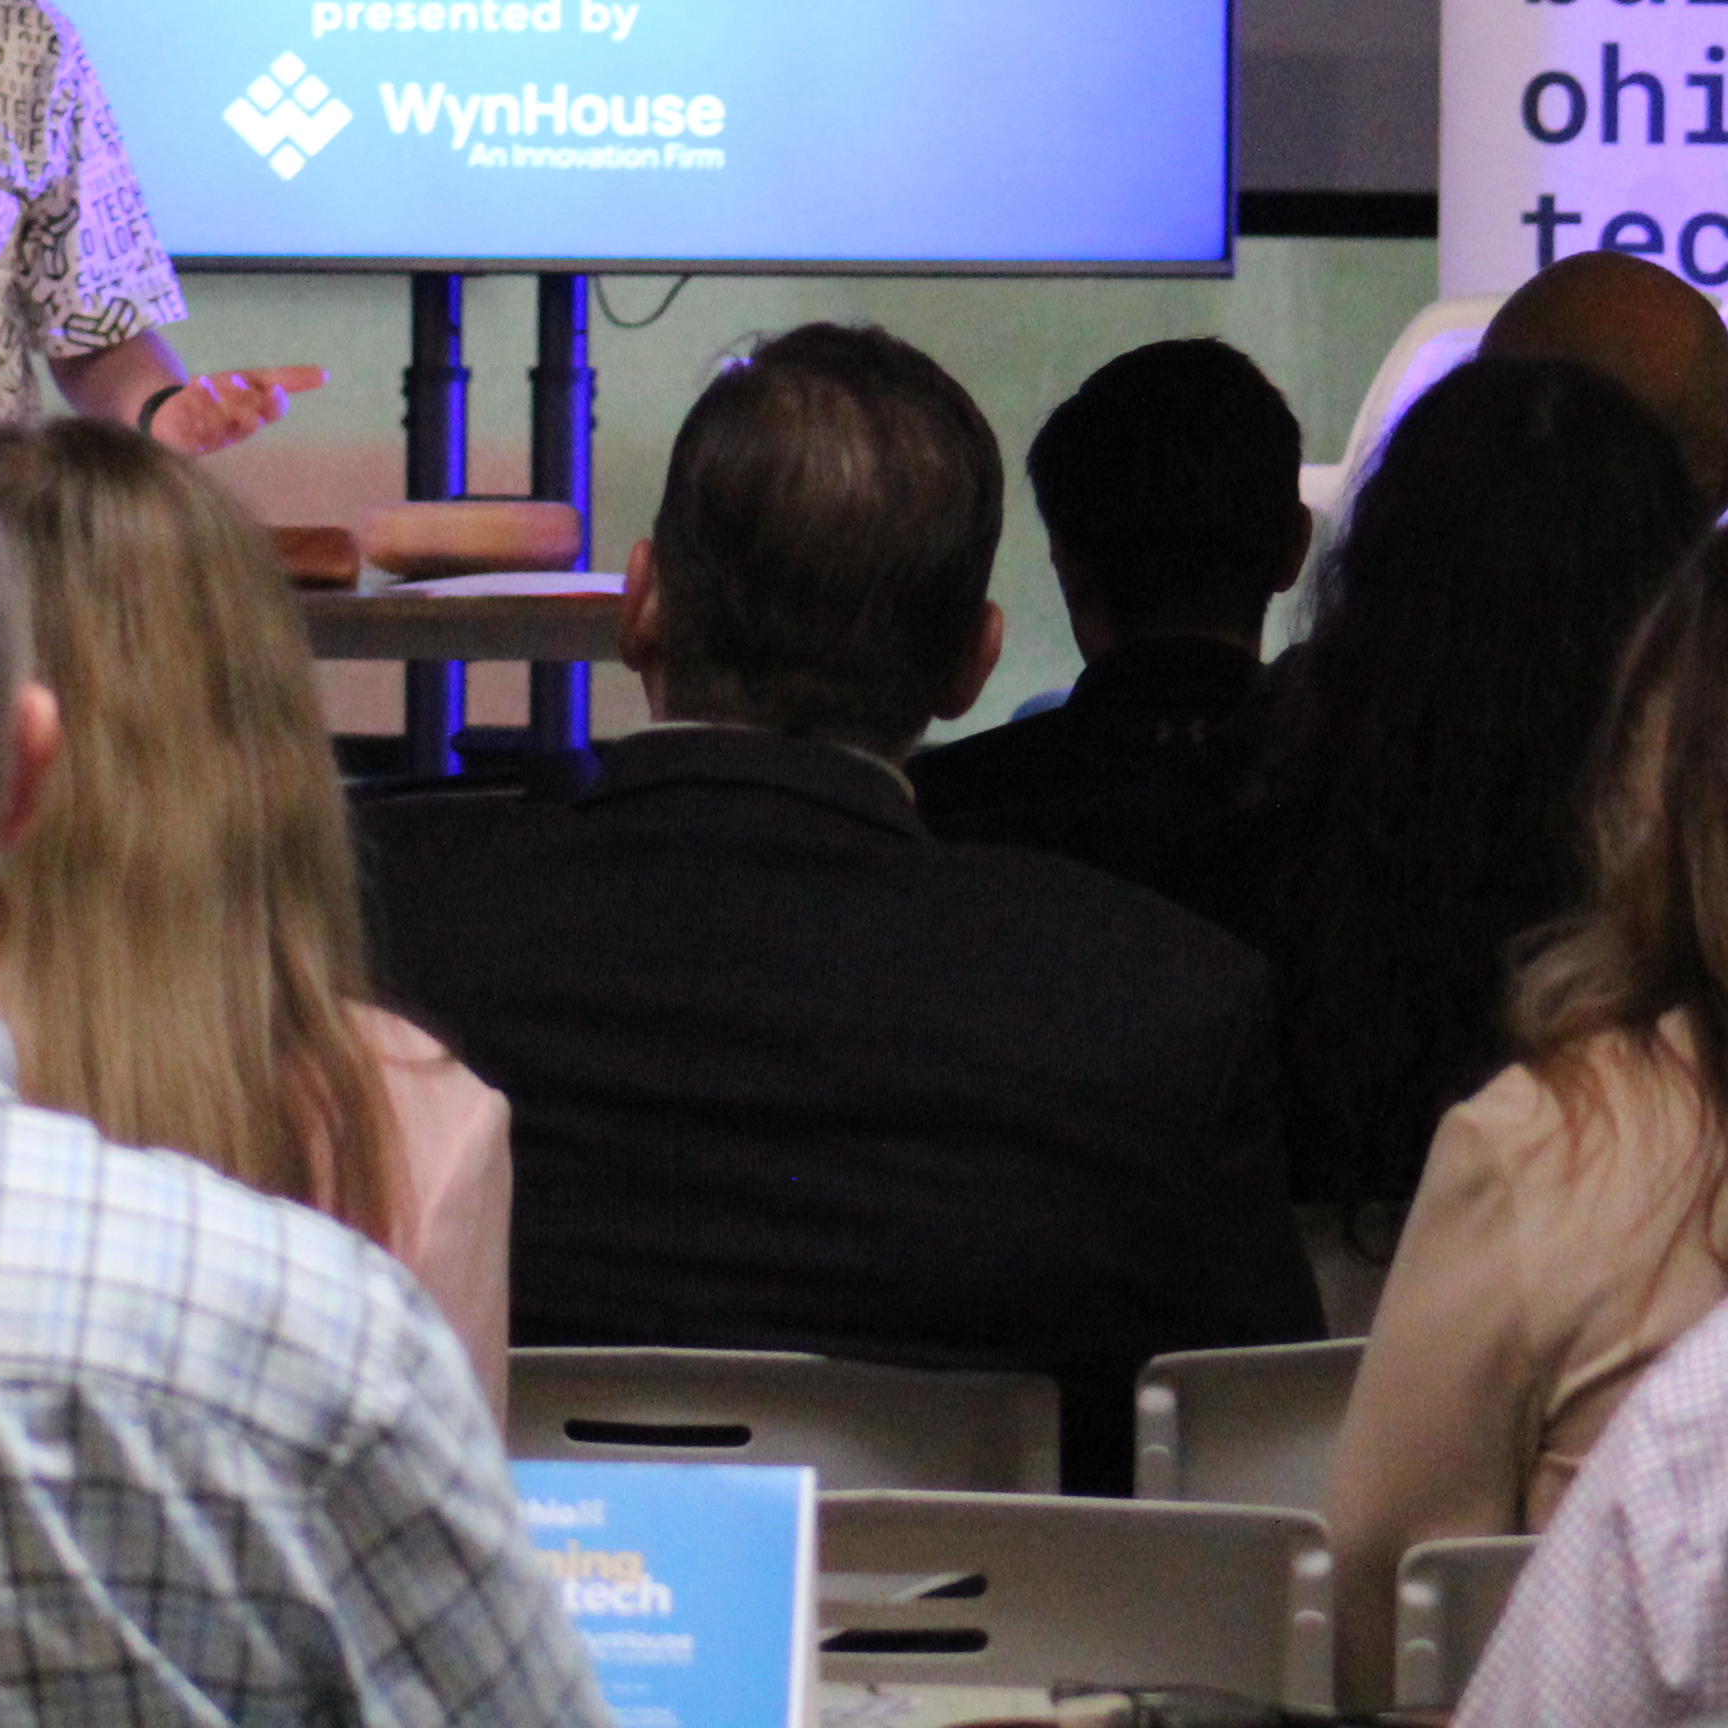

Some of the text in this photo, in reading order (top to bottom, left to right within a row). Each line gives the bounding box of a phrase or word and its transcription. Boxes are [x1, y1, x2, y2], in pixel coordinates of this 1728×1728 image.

[378, 81, 727, 151] WynHouse
[467, 143, 726, 170] An Innovation Firm
[562, 1572, 673, 1617] tech
